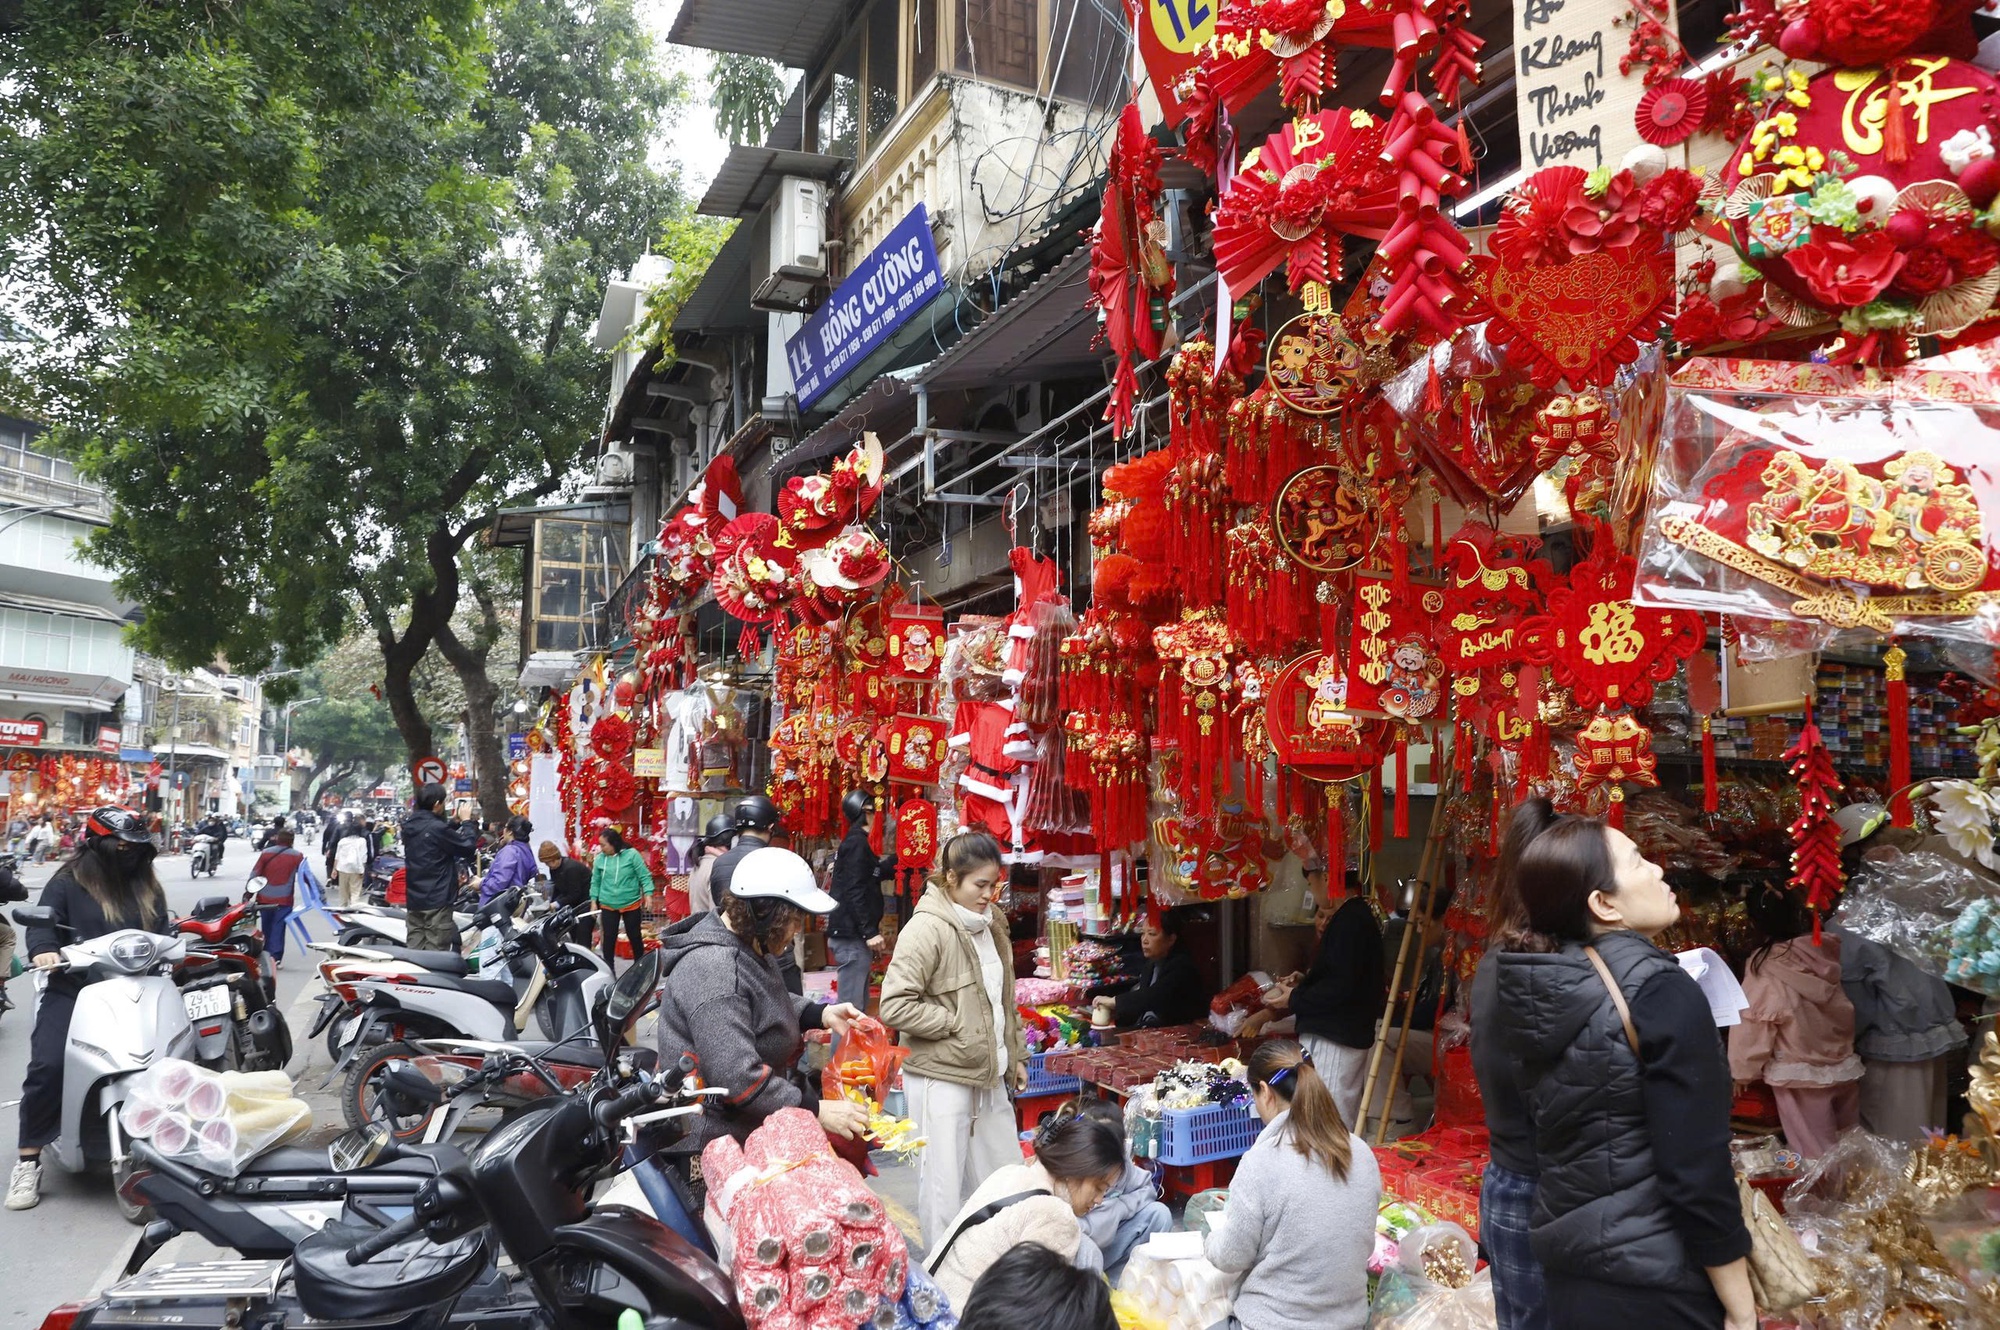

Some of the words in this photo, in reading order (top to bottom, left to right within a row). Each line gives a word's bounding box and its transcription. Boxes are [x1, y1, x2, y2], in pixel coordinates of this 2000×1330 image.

[1157, 0, 1211, 43] 12
[1524, 0, 1564, 30] An
[1521, 31, 1602, 78] Khang
[820, 299, 862, 357] HỒNG
[862, 236, 923, 315] CƯỜNG
[790, 336, 813, 382] 14
[1360, 581, 1391, 607] CHÚC
[1579, 599, 1645, 665] 福
[9, 673, 31, 681] MAI
[513, 749, 526, 758] 24
